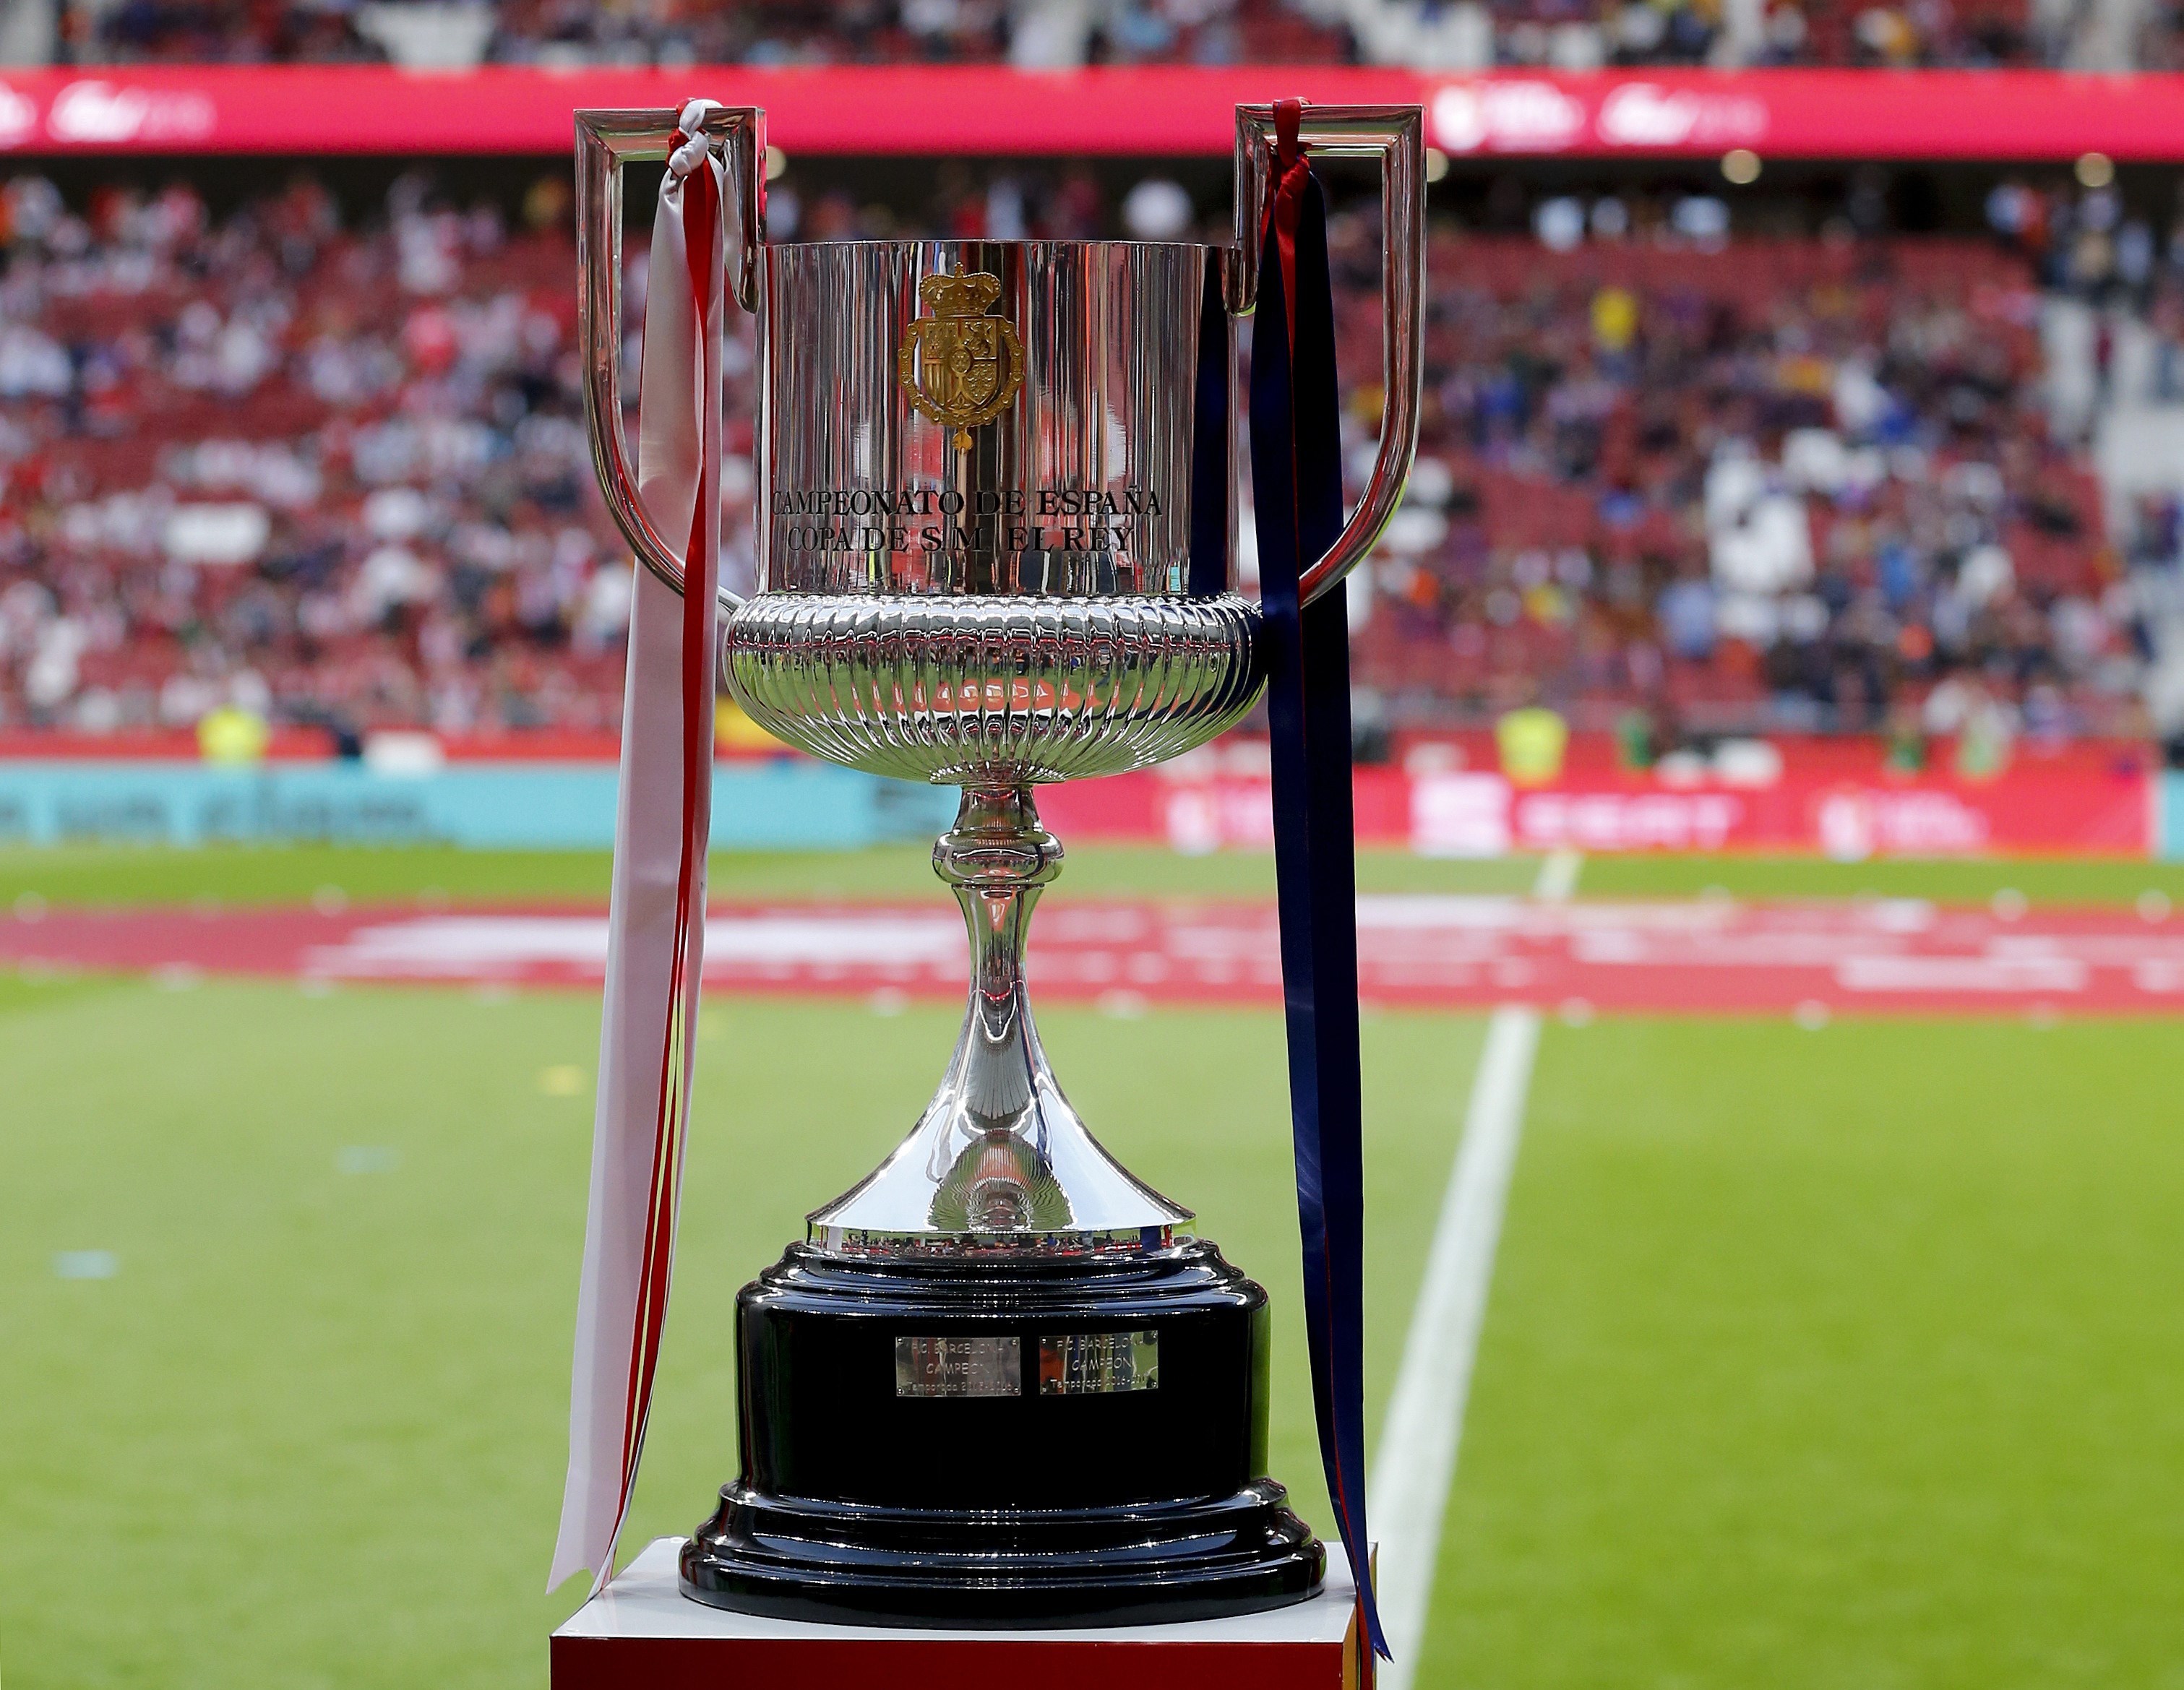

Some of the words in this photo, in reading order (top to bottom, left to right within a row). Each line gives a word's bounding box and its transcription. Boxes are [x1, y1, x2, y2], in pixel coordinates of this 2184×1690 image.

[773, 490, 965, 515] CAMPEONATO
[975, 490, 1026, 514] DE
[1036, 485, 1163, 515] ESPAÑA
[788, 527, 854, 551] COPA
[861, 527, 909, 551] DE
[1007, 527, 1054, 551] EL
[1062, 527, 1135, 551] REY
[934, 1342, 1005, 1355] BRCEO
